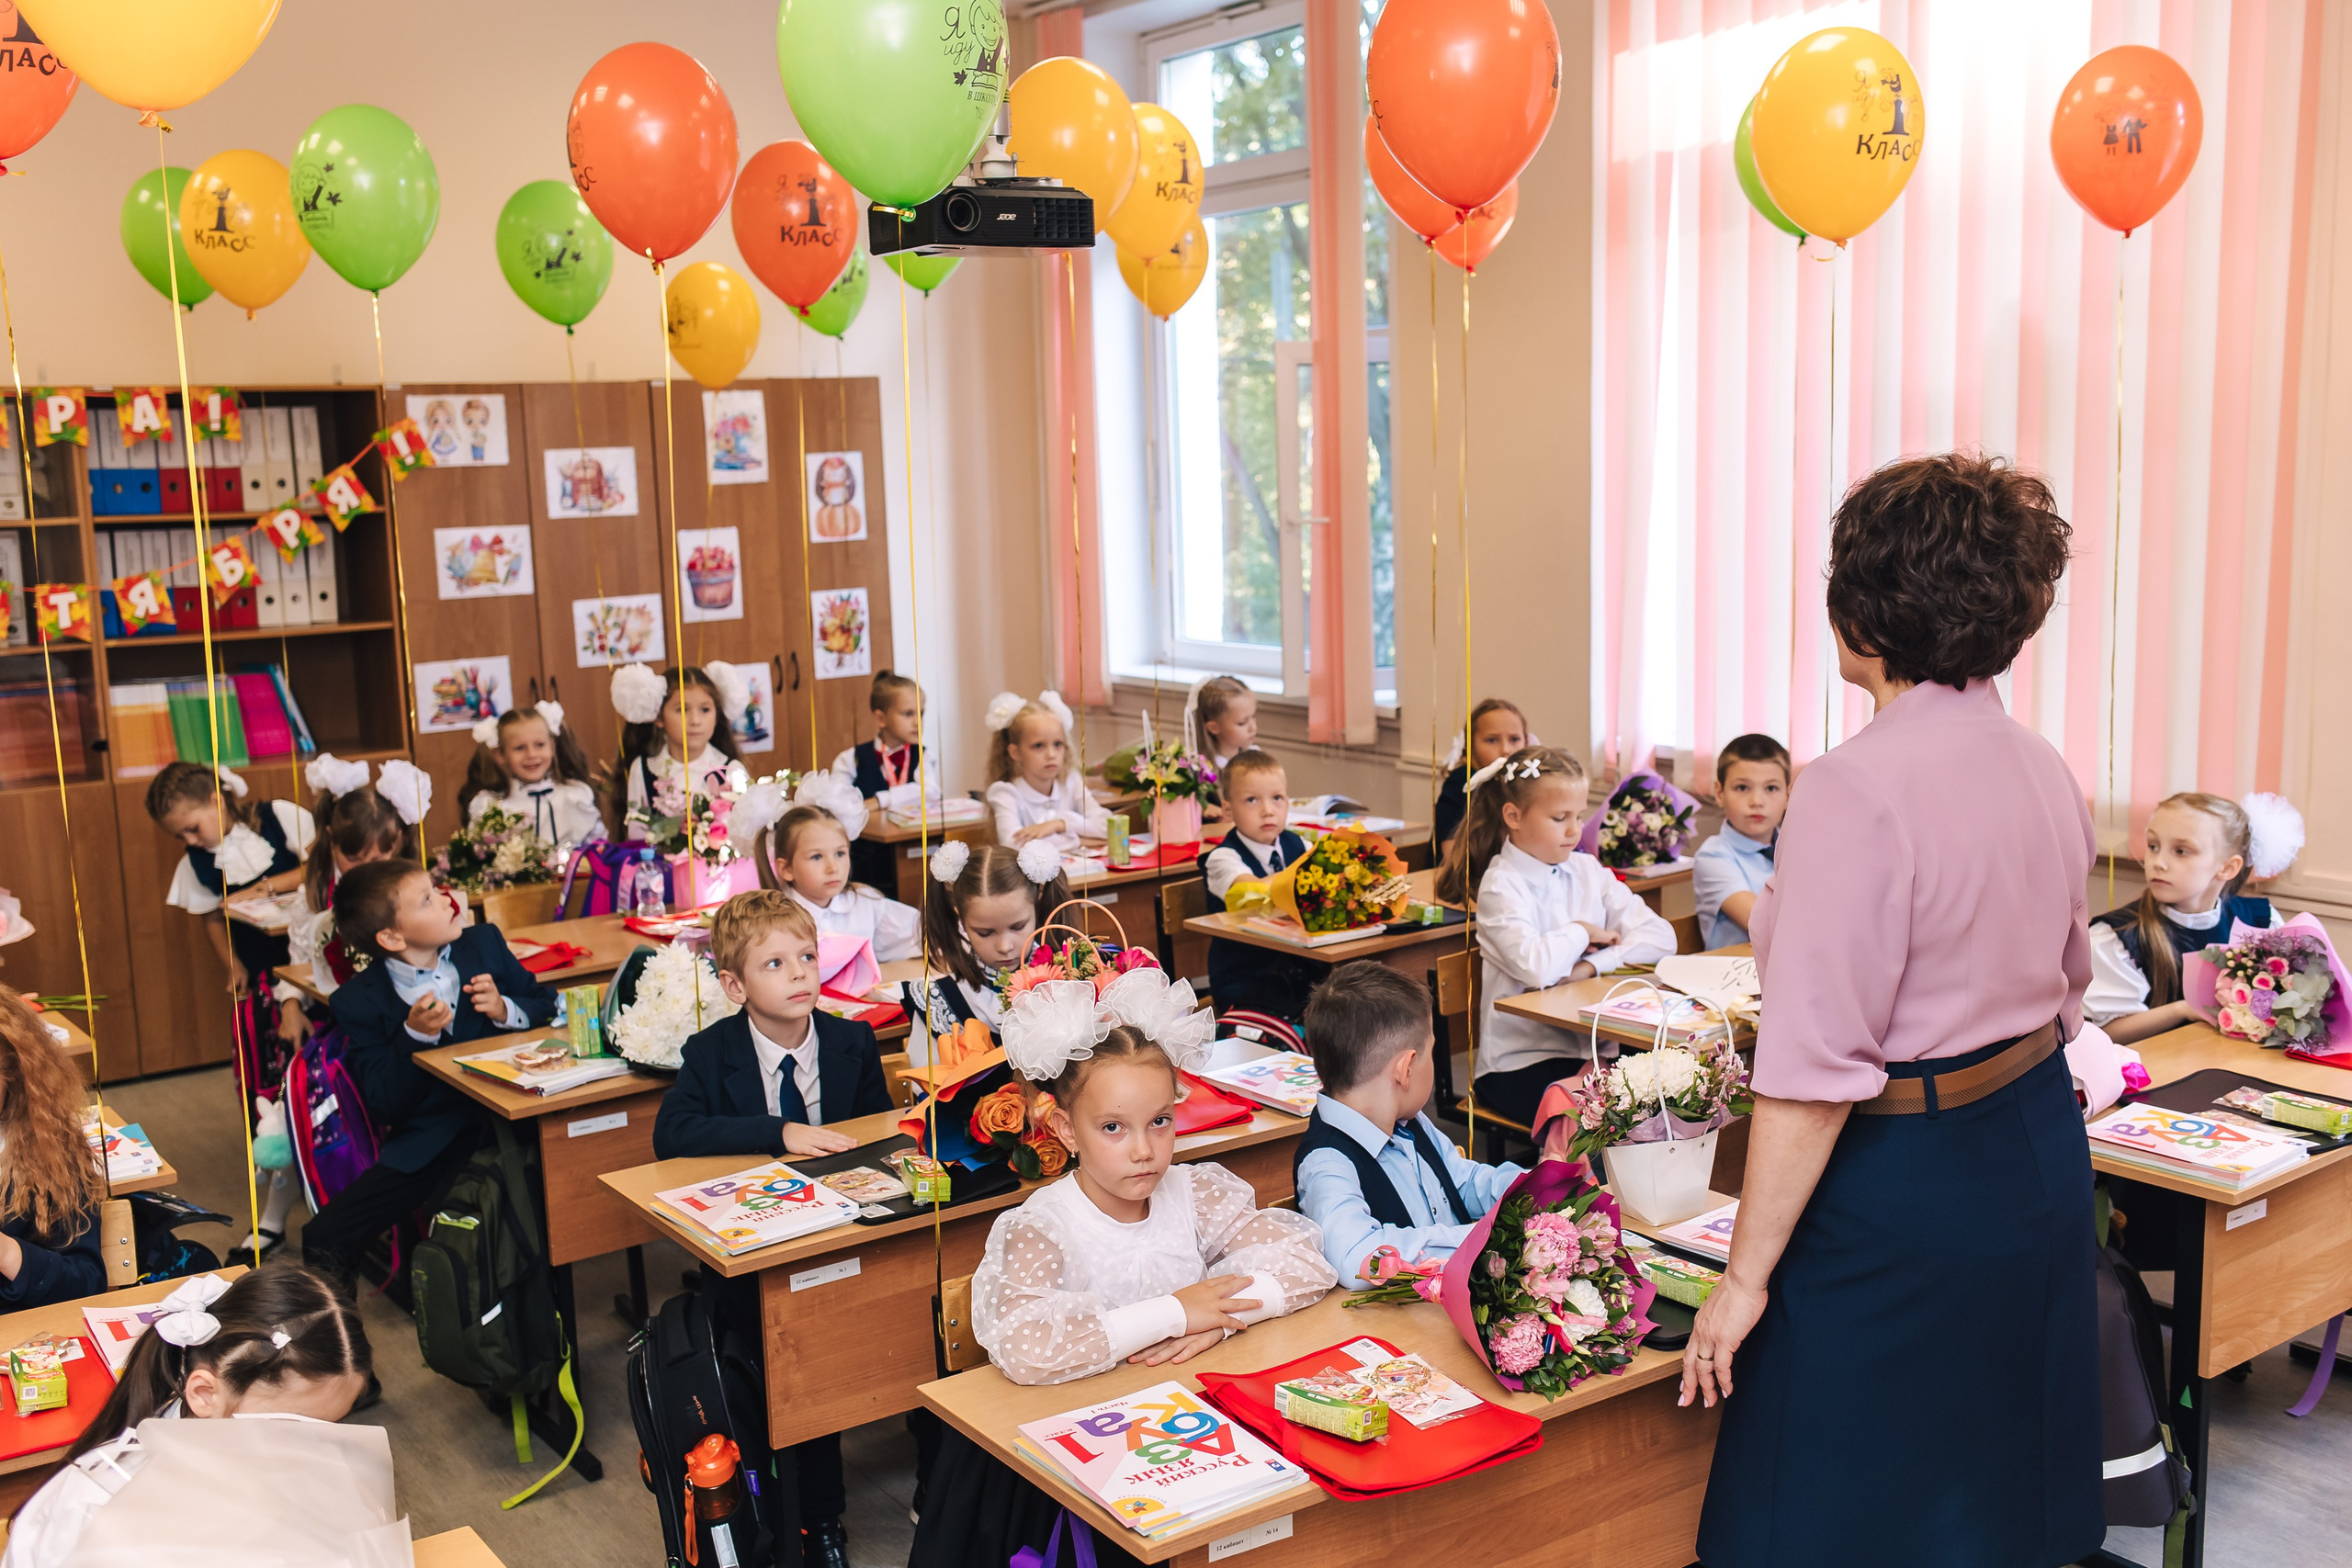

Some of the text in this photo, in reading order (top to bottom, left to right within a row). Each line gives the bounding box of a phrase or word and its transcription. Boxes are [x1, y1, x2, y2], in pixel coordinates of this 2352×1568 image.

[939, 6, 967, 41] Я
[943, 40, 976, 66] иду
[1856, 133, 1921, 162] КЛАСС
[194, 227, 256, 253] КЛАСС
[779, 223, 843, 247] КЛАСС
[1044, 1427, 1073, 1439] класс
[1044, 1430, 1104, 1464] 1
[1154, 1453, 1254, 1488] Русский
[1216, 1543, 1224, 1551] 12
[1223, 1538, 1245, 1551] кабинет
[1272, 1527, 1280, 1535] 14
